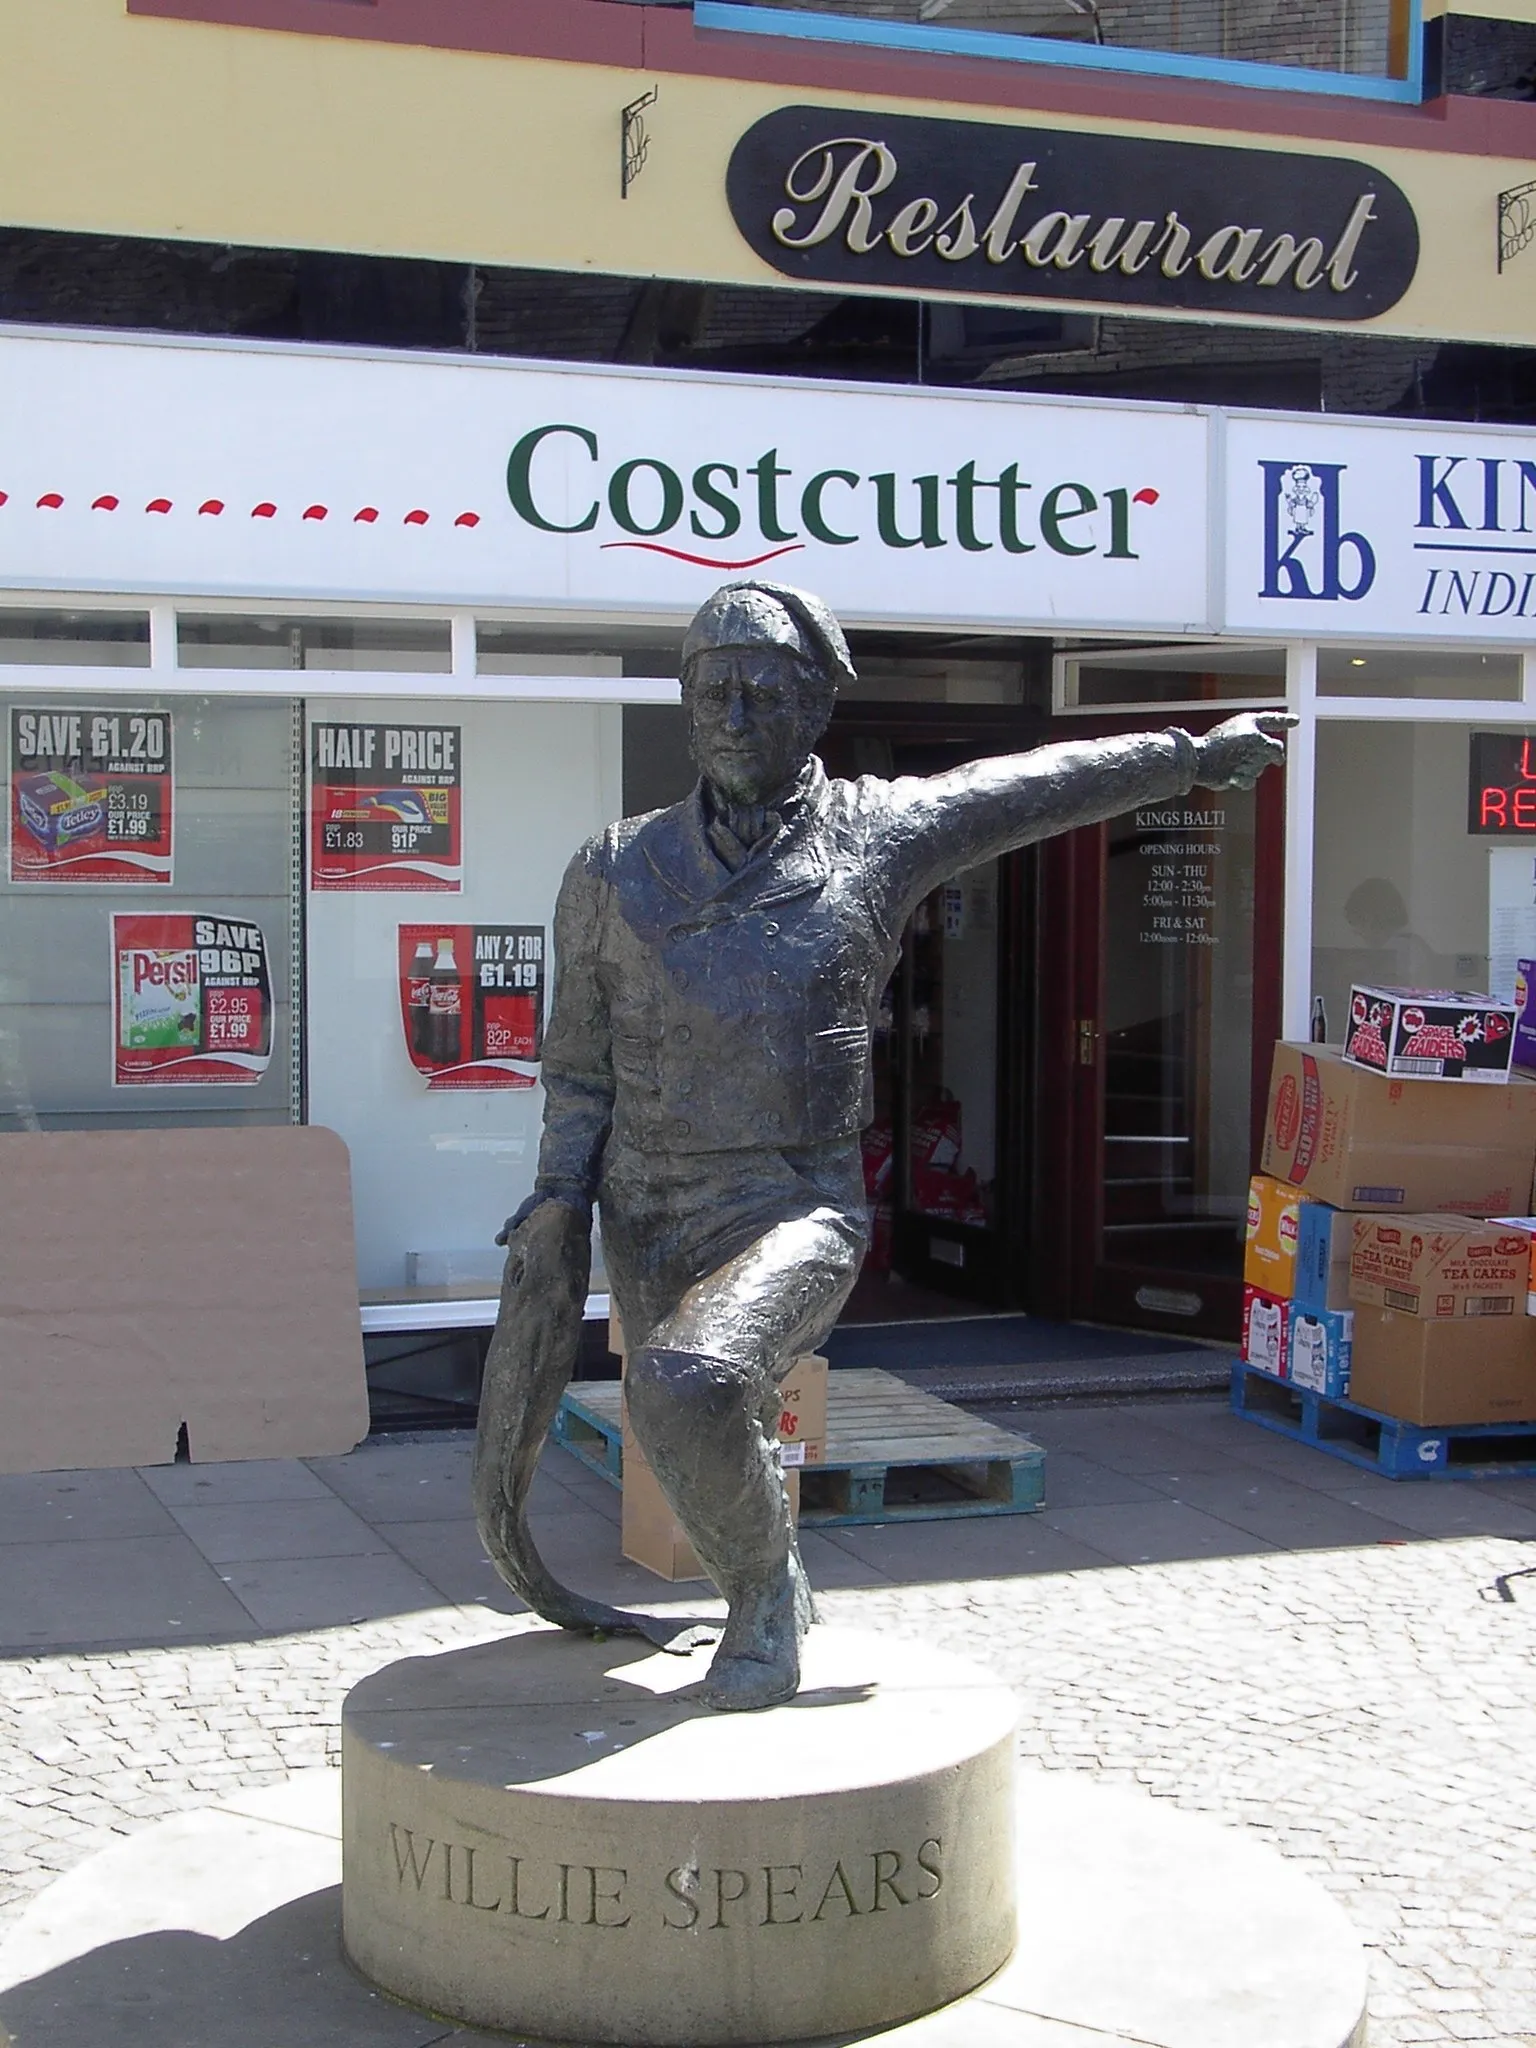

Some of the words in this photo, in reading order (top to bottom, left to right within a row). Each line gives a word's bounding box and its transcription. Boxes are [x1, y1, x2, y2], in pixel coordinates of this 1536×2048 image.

[773, 137, 1376, 292] Restaurant
[507, 423, 1160, 559] Costcutter
[1416, 569, 1536, 618] INDI
[19, 715, 81, 756] SAVE
[91, 717, 164, 758] £1.20
[319, 728, 376, 768] HALF
[385, 730, 454, 770] PRICE
[108, 763, 144, 773] AGAINST
[402, 775, 436, 784] AGAINST
[108, 794, 148, 810] £3.19
[64, 808, 99, 828] Tetley
[108, 811, 125, 819] OUR
[127, 811, 151, 820] PRICE
[1136, 811, 1180, 826] KINGS
[1184, 810, 1225, 825] BALTI
[108, 819, 147, 835] £1.99
[391, 825, 408, 833] OUR
[409, 825, 432, 834] PRICE
[326, 832, 364, 848] £1.83
[392, 833, 417, 848] 91P
[1140, 844, 1183, 855] OPENING
[1186, 844, 1221, 855] HOURS
[1152, 865, 1175, 876] SUN
[1183, 865, 1207, 876] THU
[1148, 881, 1173, 891] 12:00
[1153, 917, 1171, 928] FRI
[1173, 917, 1182, 928] &
[1185, 917, 1206, 928] SAT
[195, 920, 262, 951] SAVE
[475, 936, 501, 960] ANY
[505, 936, 514, 960] 2
[518, 936, 542, 960] FOR
[200, 949, 261, 974] 96P
[134, 953, 198, 995] Persil
[205, 977, 240, 986] AGAINST
[480, 963, 537, 987] £1.19
[210, 998, 248, 1014] £2.95
[210, 1015, 227, 1023] OUR
[228, 1015, 251, 1023] PRICE
[210, 1023, 248, 1038] £1.99
[487, 1030, 511, 1045] 82P
[1416, 1024, 1455, 1039] SPACE
[1402, 1036, 1466, 1061] RAIDERS
[1277, 1076, 1295, 1150] WALKERS
[1297, 1114, 1316, 1166] 50%
[1442, 1269, 1469, 1280] TEA
[1473, 1269, 1516, 1280] CAKES
[778, 1411, 798, 1436] RS
[389, 1822, 632, 1928] WILLIE
[662, 1837, 944, 1931] SPEARS
